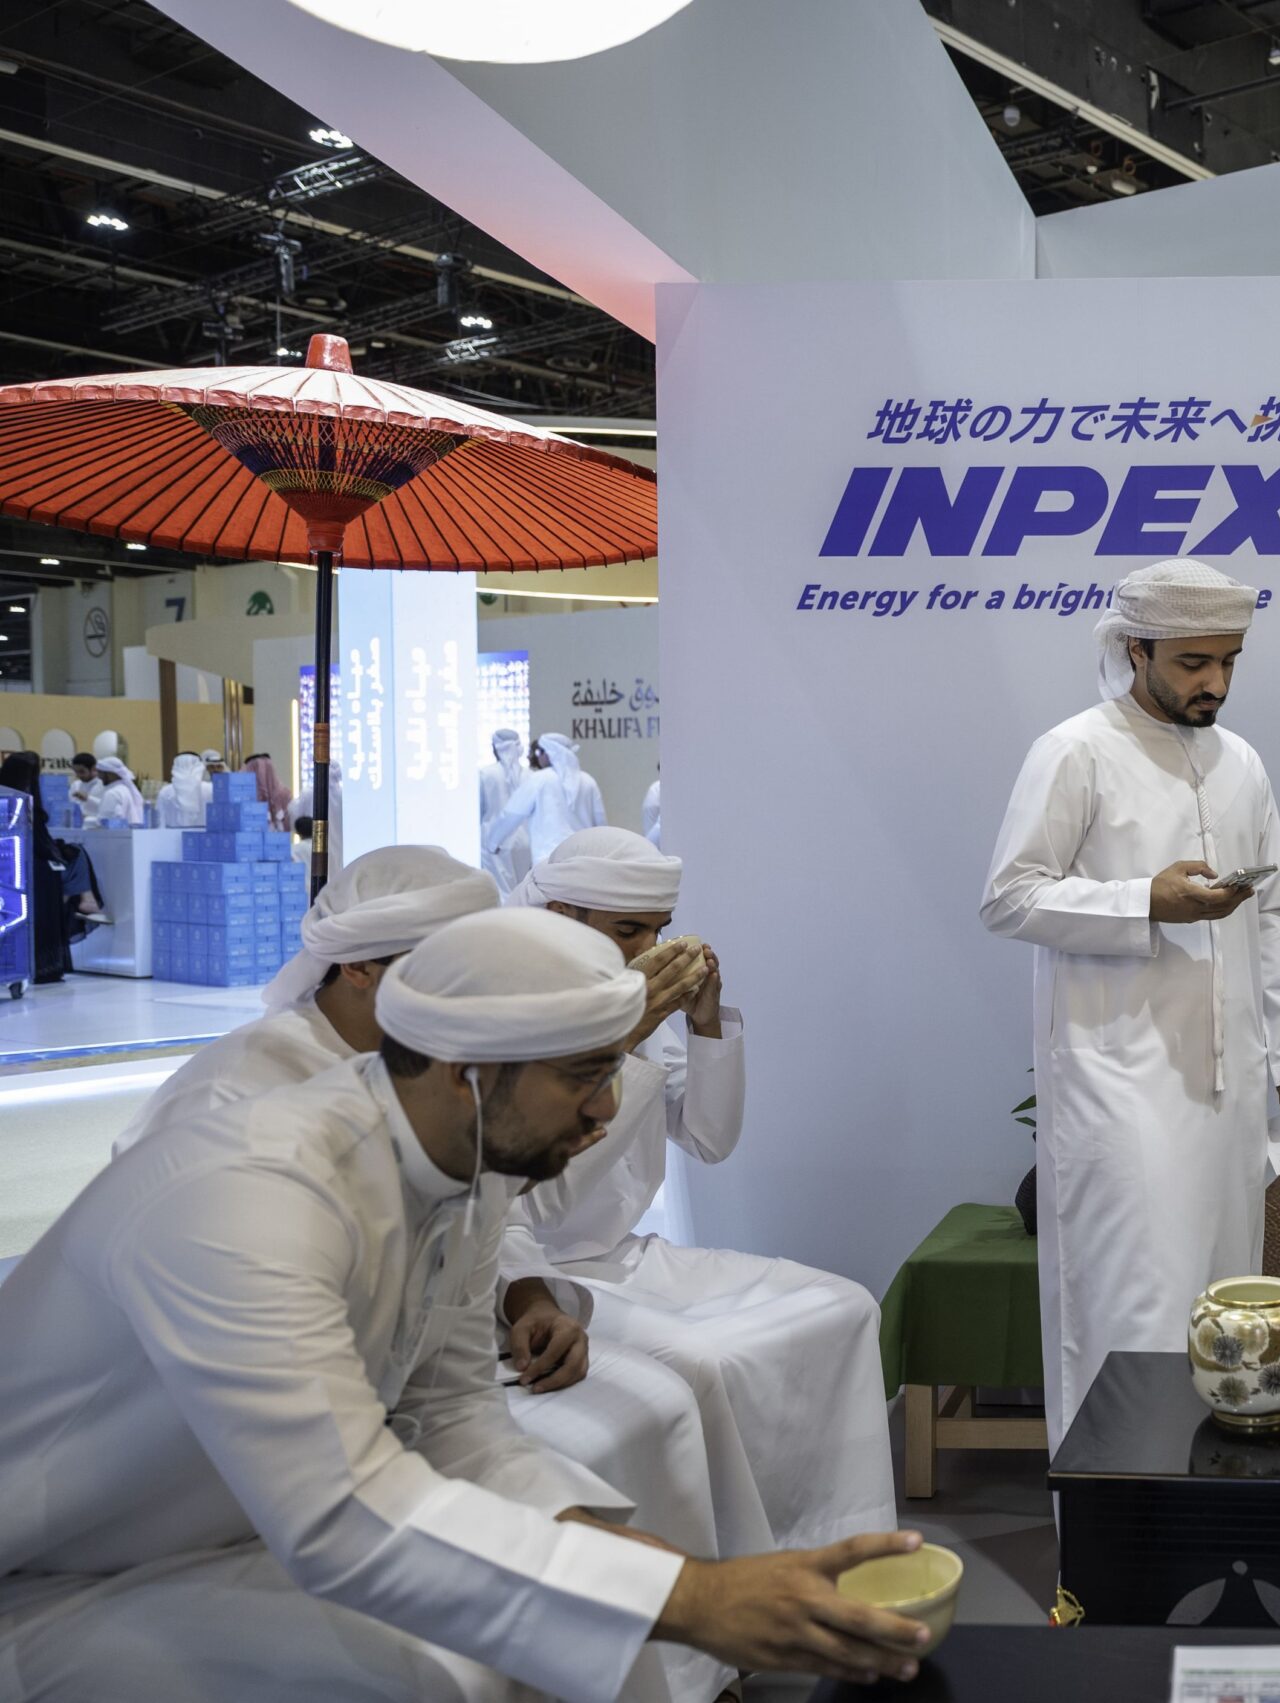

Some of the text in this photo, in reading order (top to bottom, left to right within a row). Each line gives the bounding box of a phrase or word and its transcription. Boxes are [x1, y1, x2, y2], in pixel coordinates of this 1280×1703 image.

[797, 582, 1115, 617] Energy for a bright
[572, 717, 642, 739] KHALIFA
